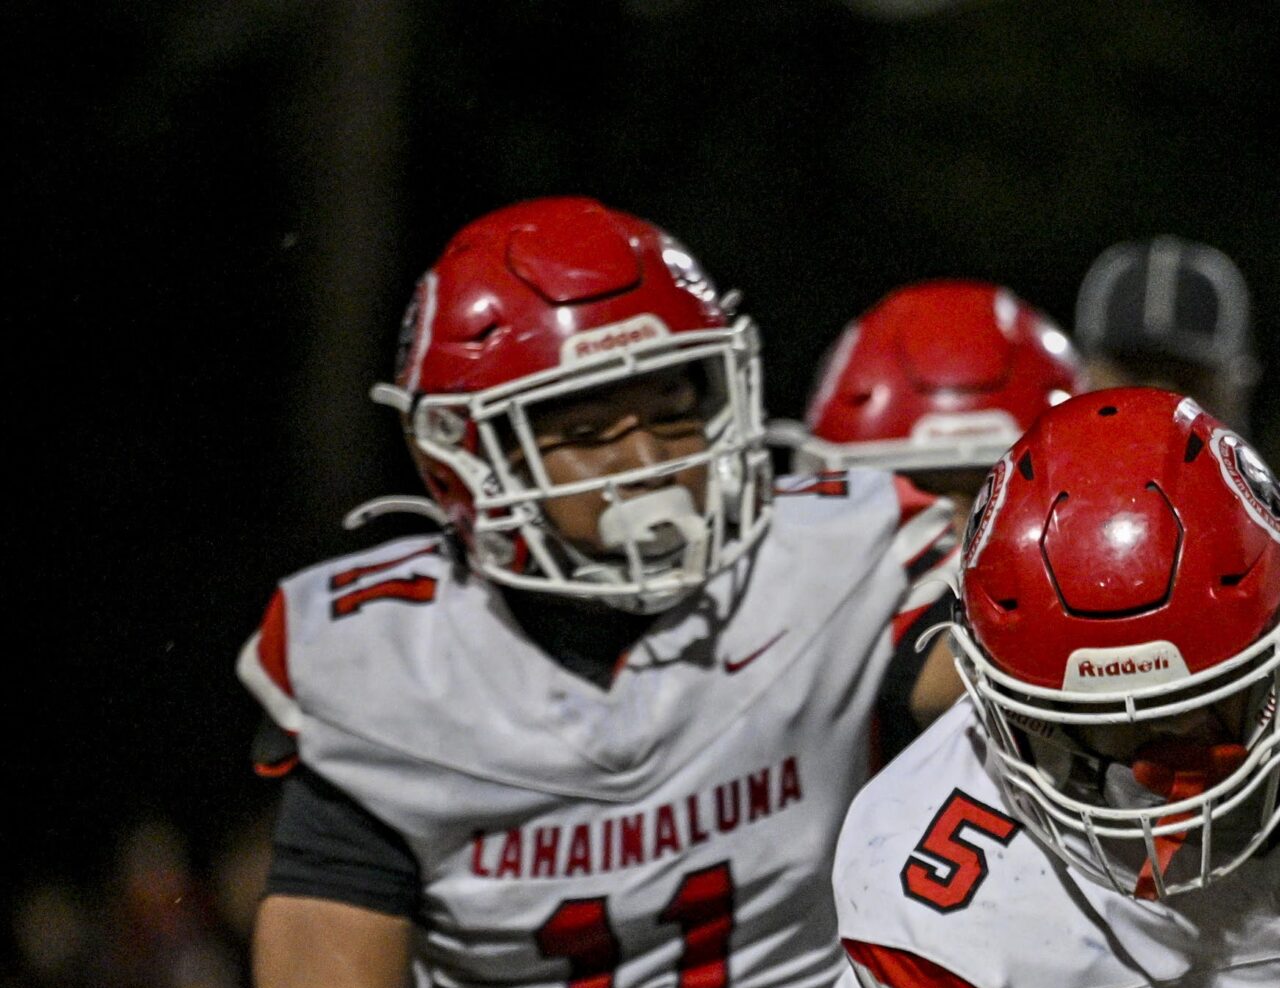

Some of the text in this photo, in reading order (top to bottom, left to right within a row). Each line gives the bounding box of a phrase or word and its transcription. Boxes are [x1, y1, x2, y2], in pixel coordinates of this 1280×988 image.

[1078, 655, 1169, 678] Riddell
[470, 756, 803, 879] LAHAINALUNA
[900, 787, 1025, 915] 5
